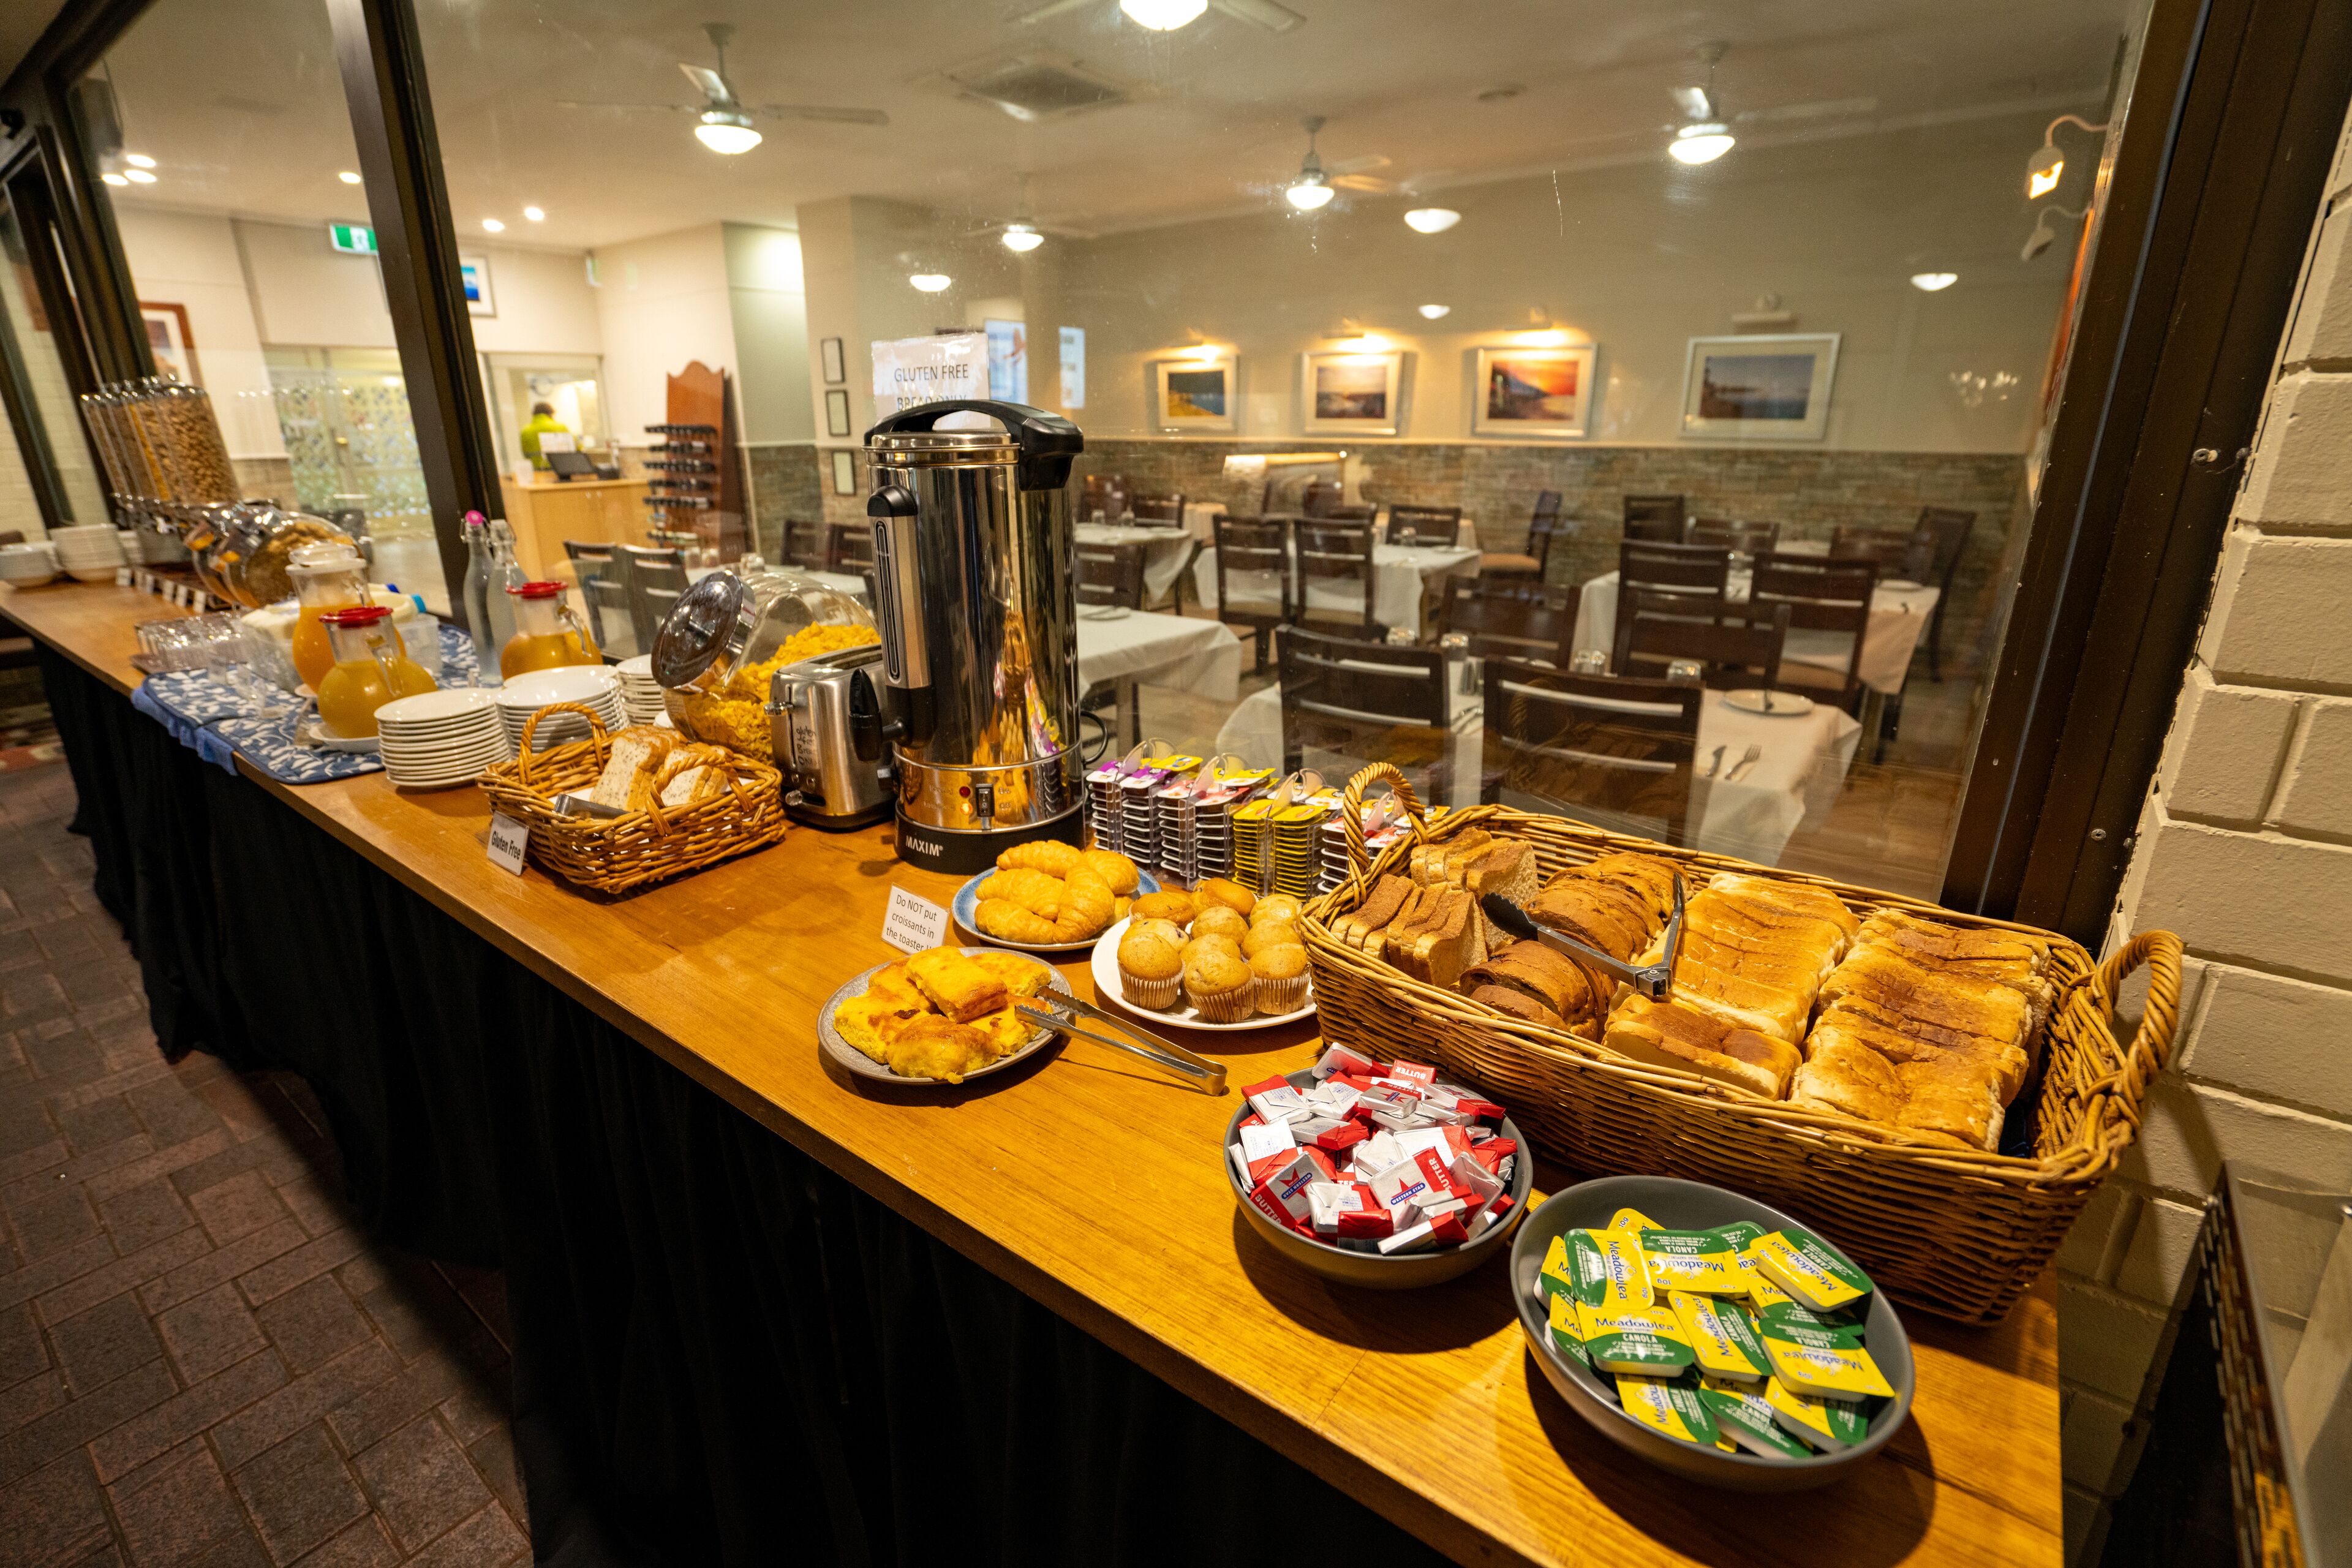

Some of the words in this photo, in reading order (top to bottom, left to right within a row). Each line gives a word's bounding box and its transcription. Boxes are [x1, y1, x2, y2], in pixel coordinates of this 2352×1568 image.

[894, 366, 938, 382] GLUTEN
[942, 364, 968, 379] FREE
[491, 831, 508, 853] Gluten
[508, 840, 521, 860] Free
[896, 895, 906, 907] Do
[907, 900, 924, 914] NOT
[924, 909, 937, 922] put
[892, 913, 926, 935] croissants
[927, 927, 934, 939] in
[886, 927, 897, 940] the
[899, 933, 924, 951] toaster
[1395, 1066, 1427, 1080] BUTTER
[1292, 1173, 1312, 1191] WESTERN
[1428, 1157, 1452, 1190] BUTTER
[1283, 1188, 1294, 1198] STAR
[1392, 1191, 1412, 1204] WESTERN
[1412, 1183, 1424, 1193] STAR
[1255, 1194, 1282, 1225] BUTTER
[1619, 1216, 1629, 1227] 10g
[1665, 1245, 1697, 1254] CANOLA
[1802, 1248, 1833, 1270] CANOLA
[1649, 1259, 1725, 1272] MeadowLa
[1623, 1333, 1658, 1344] CANOLA
